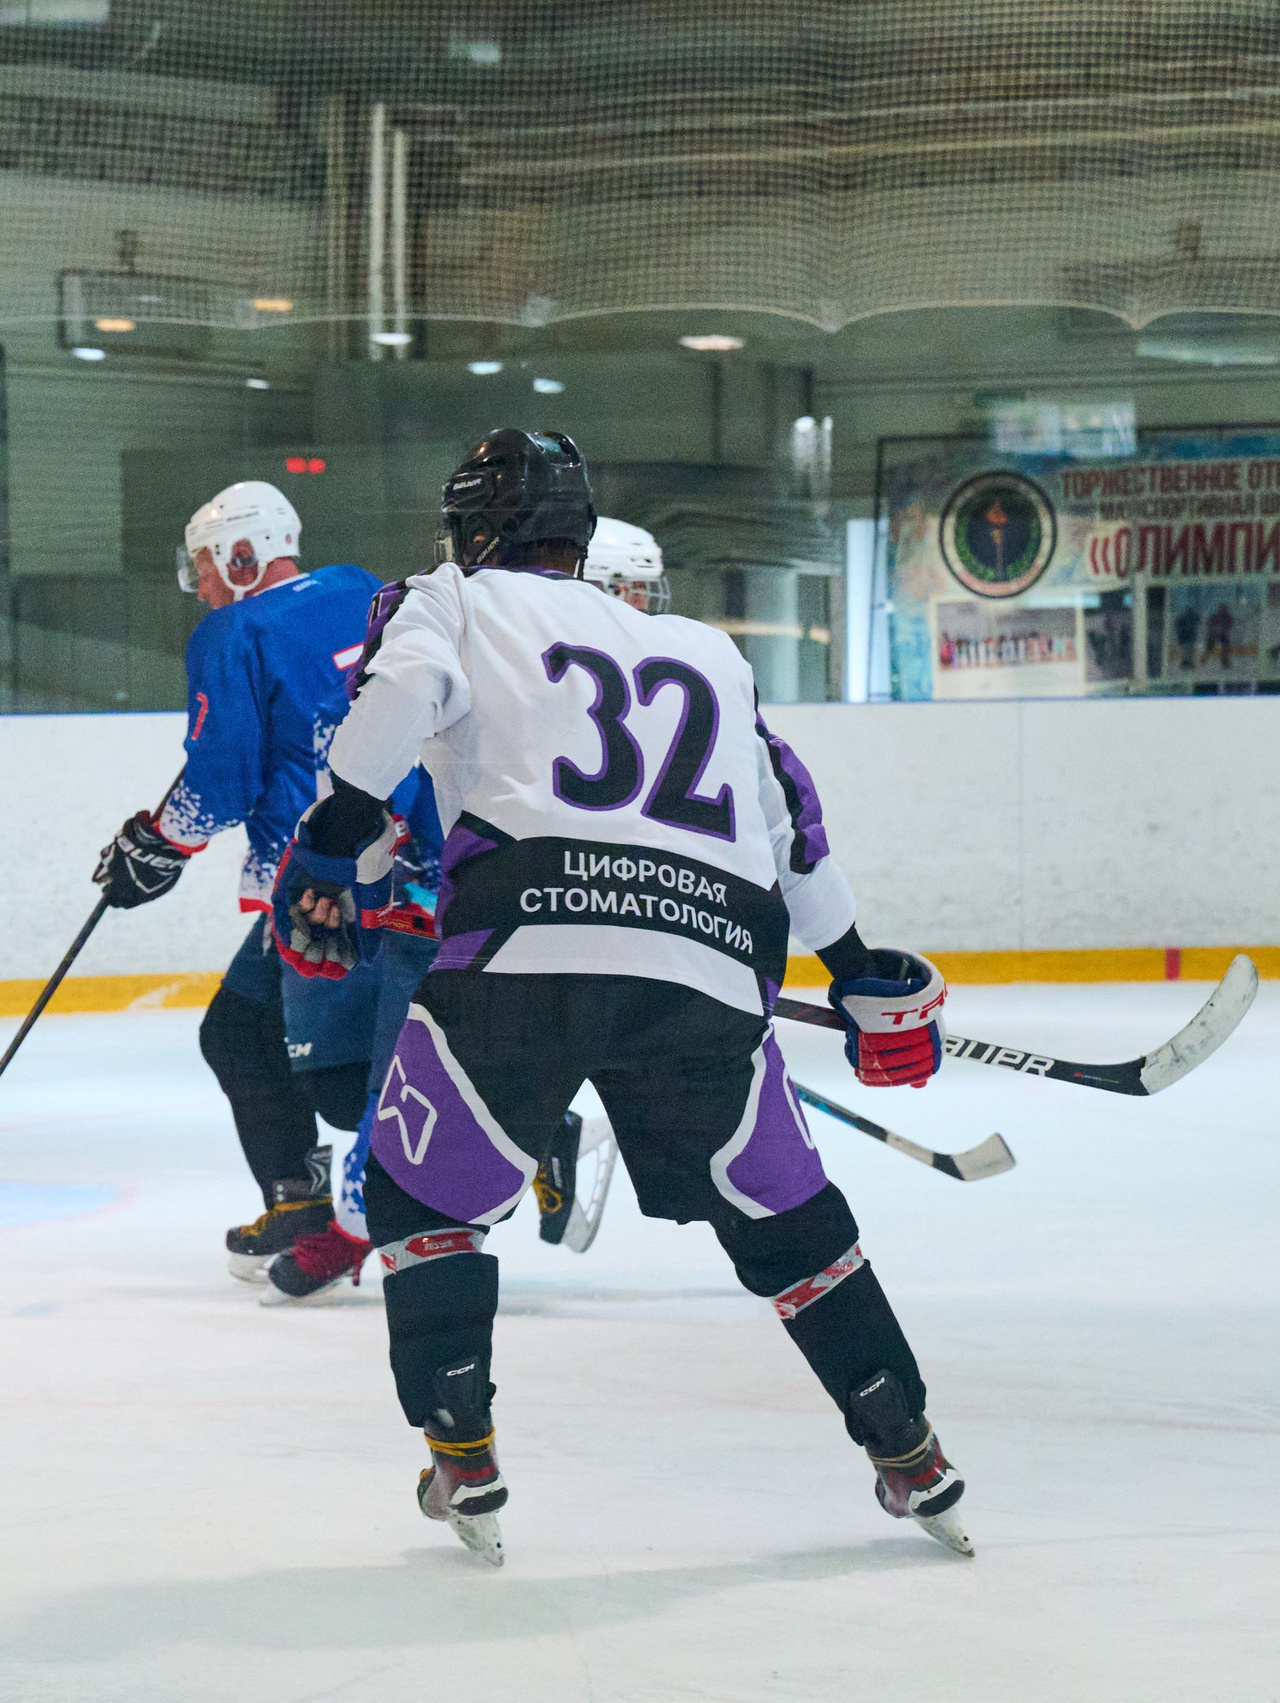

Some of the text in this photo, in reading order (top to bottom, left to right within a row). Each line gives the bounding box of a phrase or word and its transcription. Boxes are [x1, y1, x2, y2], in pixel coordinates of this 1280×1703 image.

[1063, 460, 1280, 498] ТОРЖЕСТВЕННОЕ ОТ
[541, 641, 736, 843] 32
[564, 850, 728, 907] ЦИФРОВАЯ
[520, 887, 753, 954] СТОМАТОЛОГИЯ
[942, 1037, 1055, 1077] AUER
[446, 1363, 475, 1377] CCM
[859, 1376, 885, 1397] CCM
